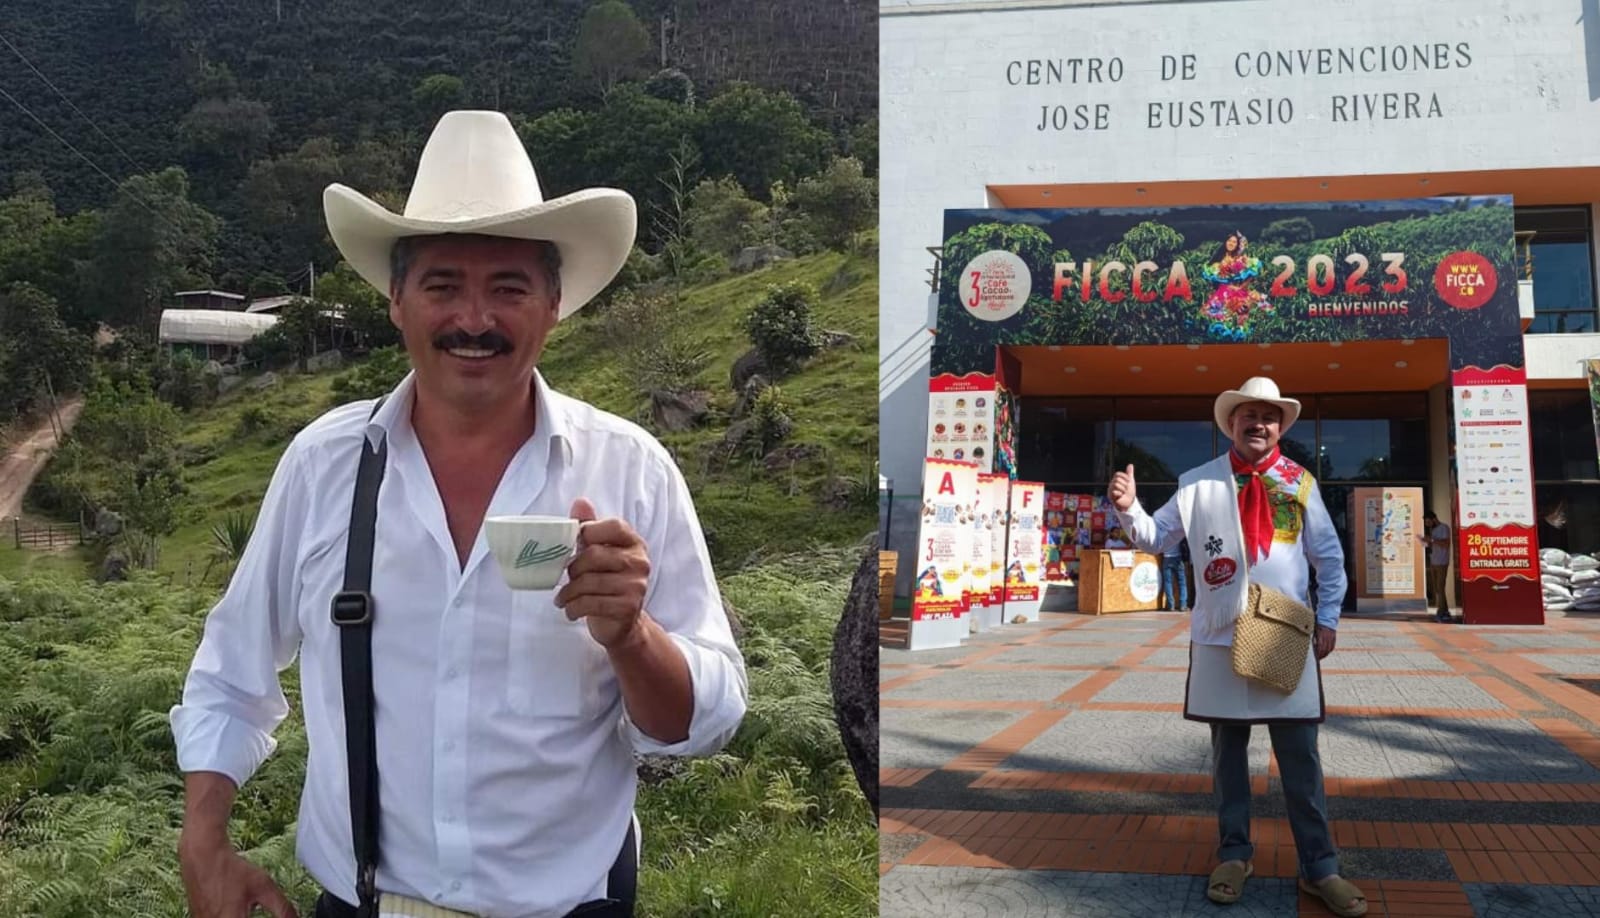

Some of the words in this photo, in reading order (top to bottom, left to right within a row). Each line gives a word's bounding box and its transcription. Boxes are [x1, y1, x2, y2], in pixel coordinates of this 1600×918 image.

[1007, 57, 1124, 85] CENTRO
[1161, 54, 1197, 81] DE
[1235, 42, 1472, 77] CONVENCIONES
[1037, 104, 1110, 131] JOSE
[1147, 97, 1294, 128] EUSTASIO
[1331, 91, 1444, 122] RIVERA
[1053, 259, 1193, 304] FICCA
[1270, 252, 1408, 297] 2023
[1446, 273, 1485, 287] FICCA
[968, 271, 981, 307] 3
[1308, 301, 1409, 317] BIENVENIDOS
[938, 471, 955, 495] A
[1023, 490, 1034, 508] F
[926, 538, 934, 562] 3
[1467, 534, 1482, 546] 28
[1481, 536, 1529, 545] SEPTIEMBRE
[1469, 547, 1480, 556] AL
[1480, 544, 1493, 556] 01
[1492, 546, 1529, 556] OCTUBRE
[1469, 559, 1504, 568] ENTRADA
[1503, 559, 1530, 568] GRATIS
